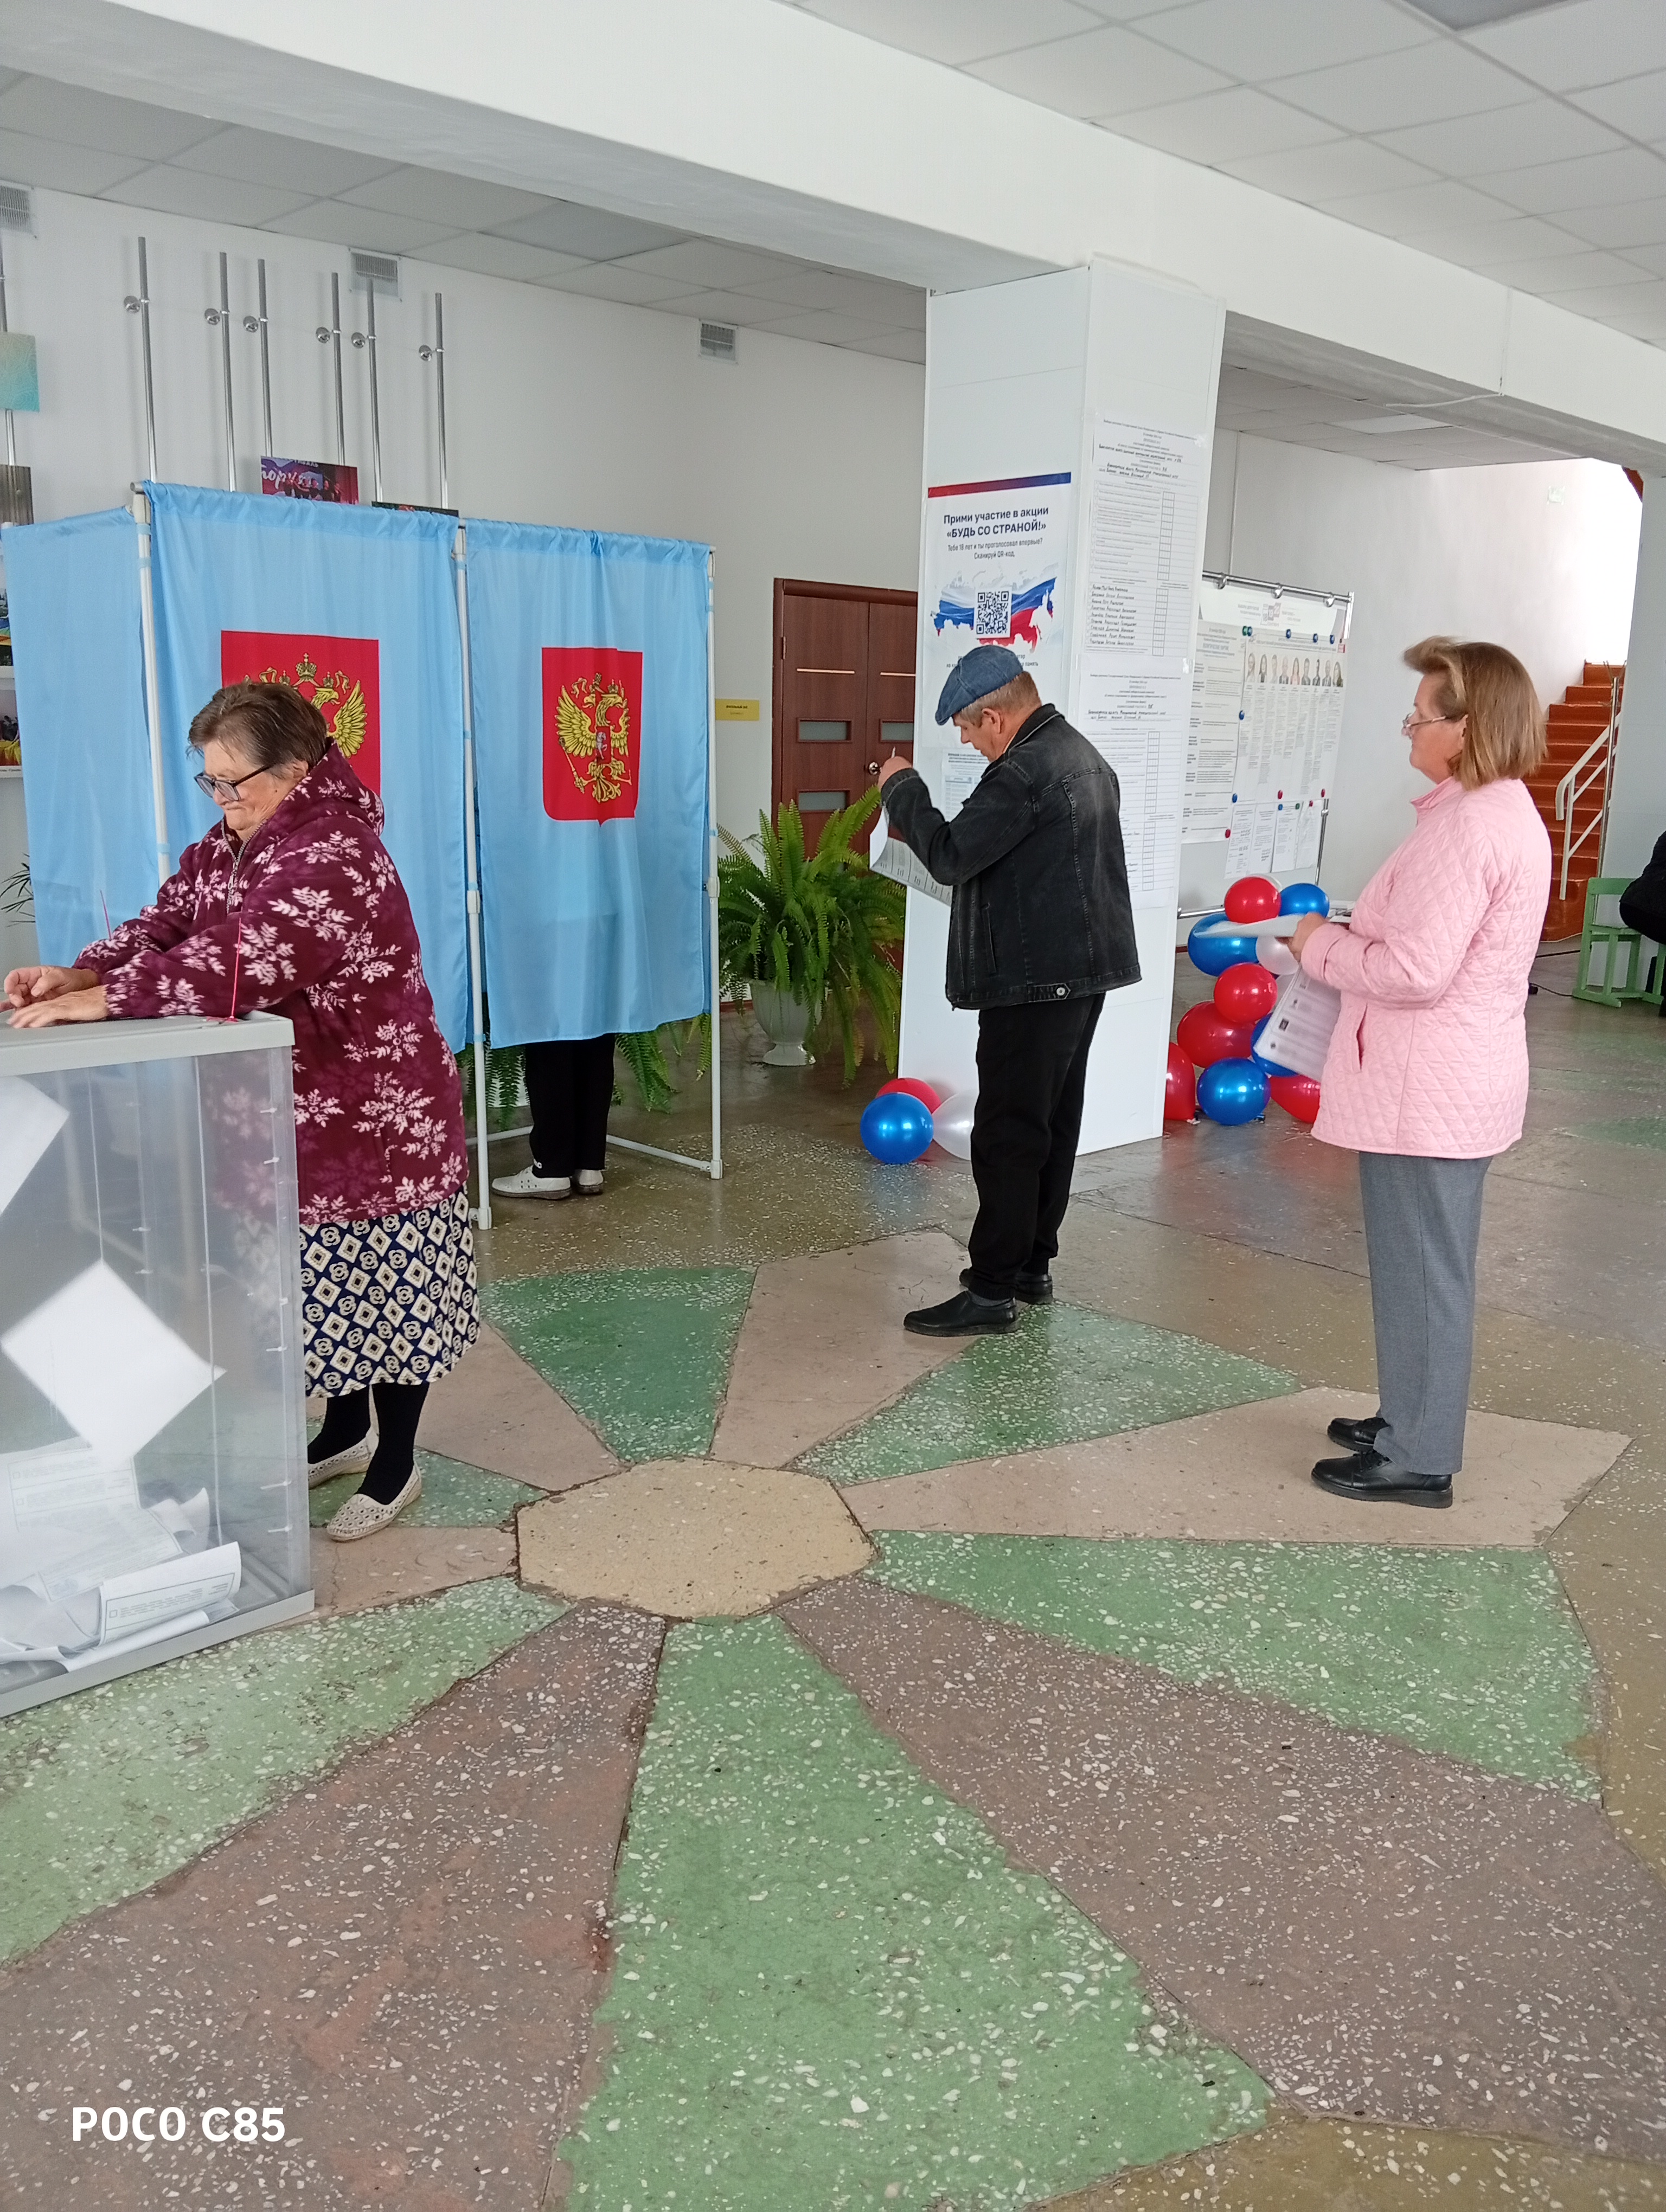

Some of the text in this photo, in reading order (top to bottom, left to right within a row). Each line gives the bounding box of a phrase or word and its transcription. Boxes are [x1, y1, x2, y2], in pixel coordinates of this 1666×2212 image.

[944, 515, 972, 525] Прими
[975, 511, 1010, 524] участие
[1020, 507, 1048, 517] акции
[947, 519, 1047, 538] «БУДЬ СО СТРАНОЙ!»
[985, 541, 1018, 550] проголосовал
[1019, 537, 1043, 547] впервые?
[974, 551, 996, 560] Сканируй
